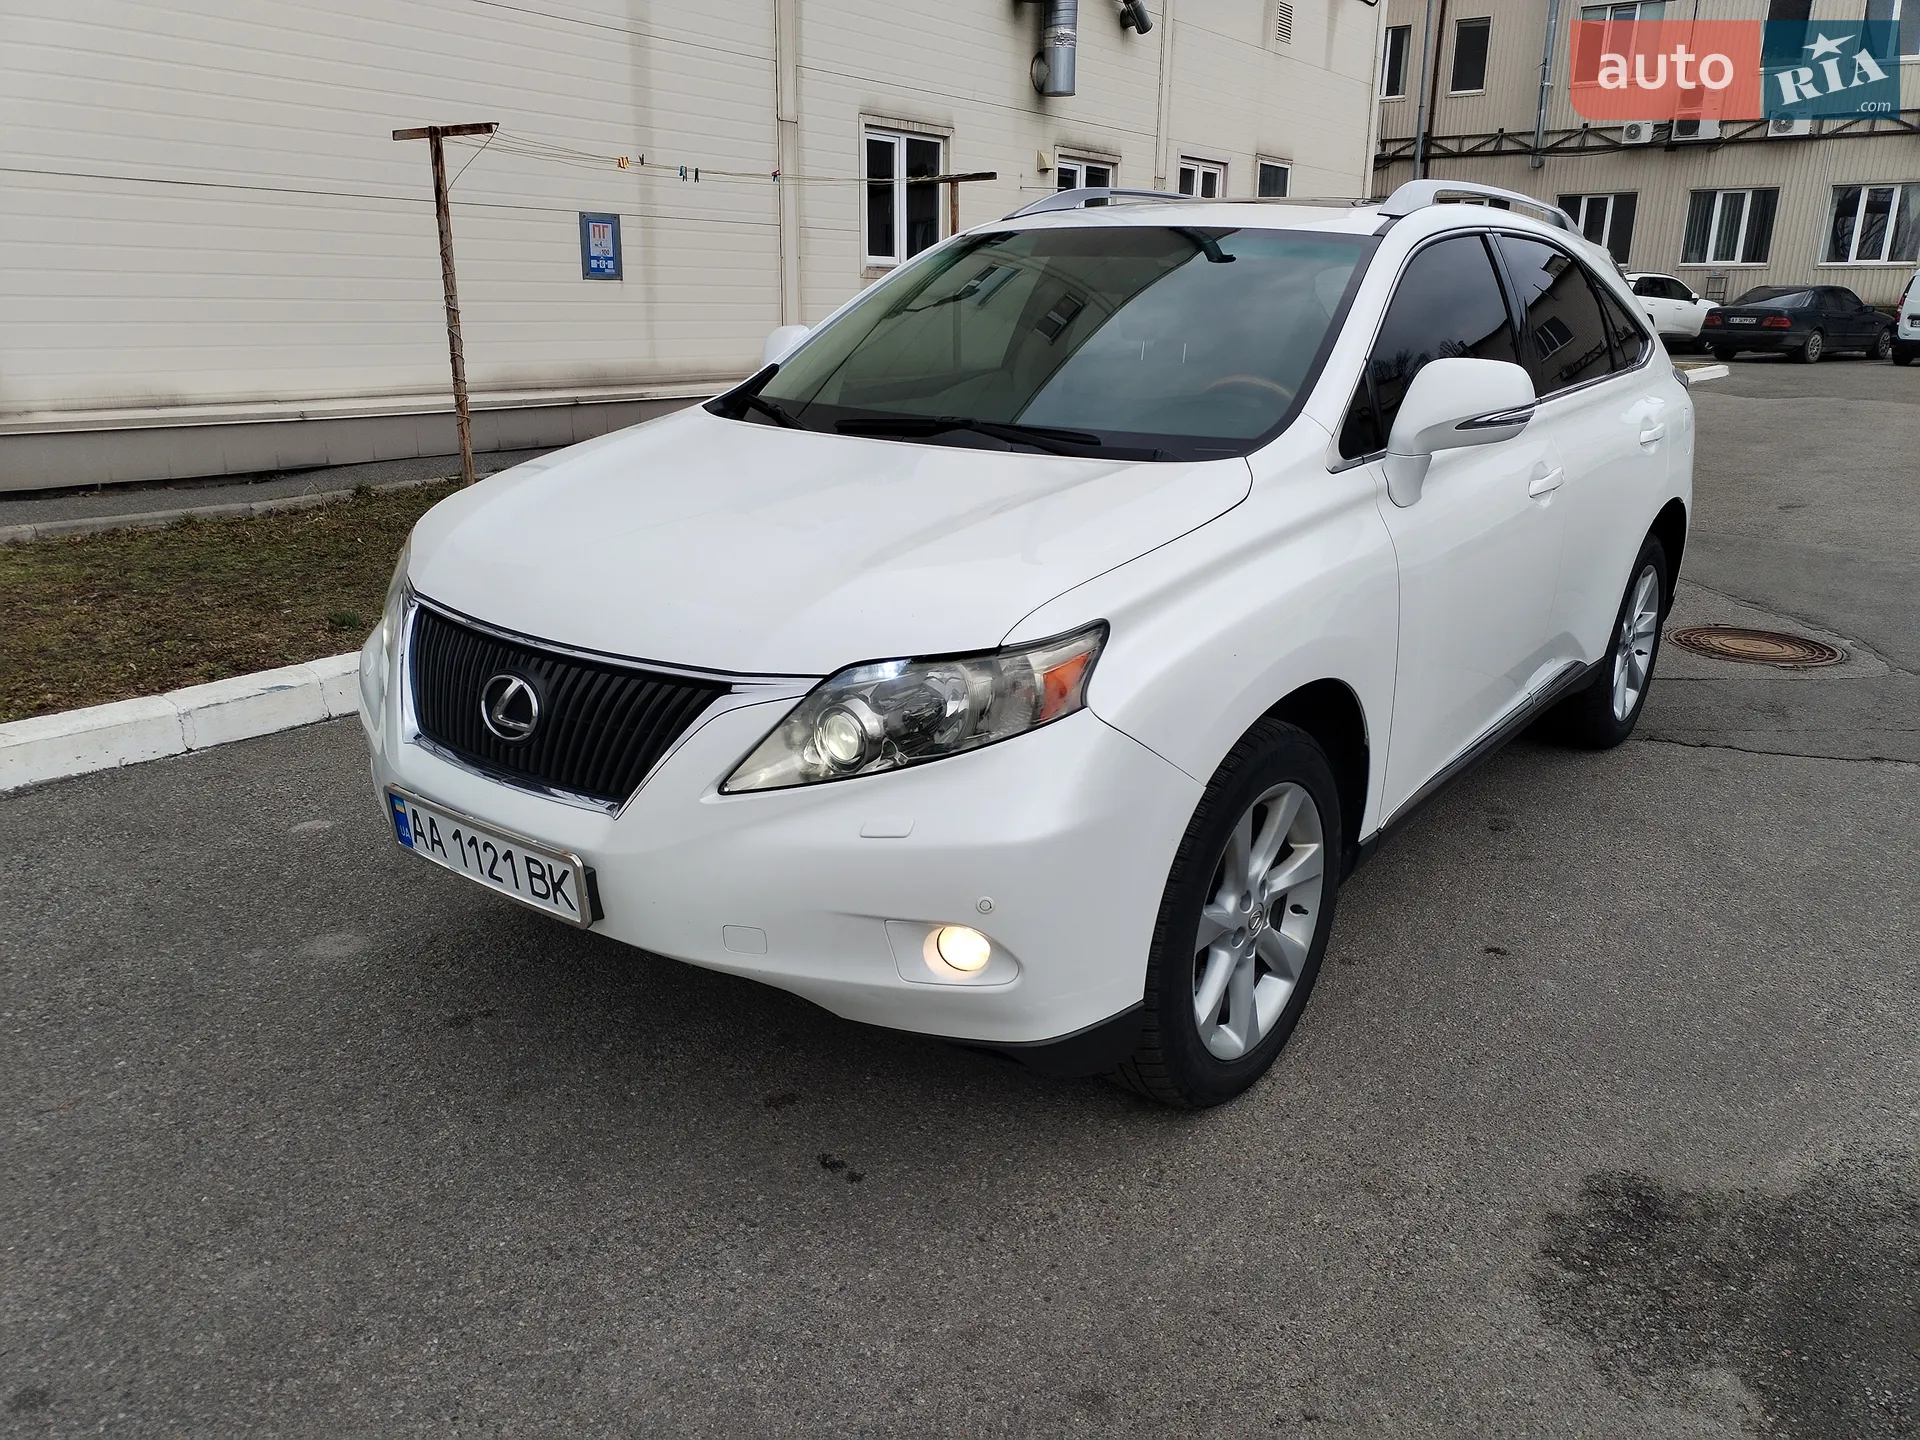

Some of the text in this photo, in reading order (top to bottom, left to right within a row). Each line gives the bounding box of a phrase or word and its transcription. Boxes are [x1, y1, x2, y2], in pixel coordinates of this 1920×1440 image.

[400, 825, 411, 839] UA
[411, 807, 577, 912] AA 1121 BK
